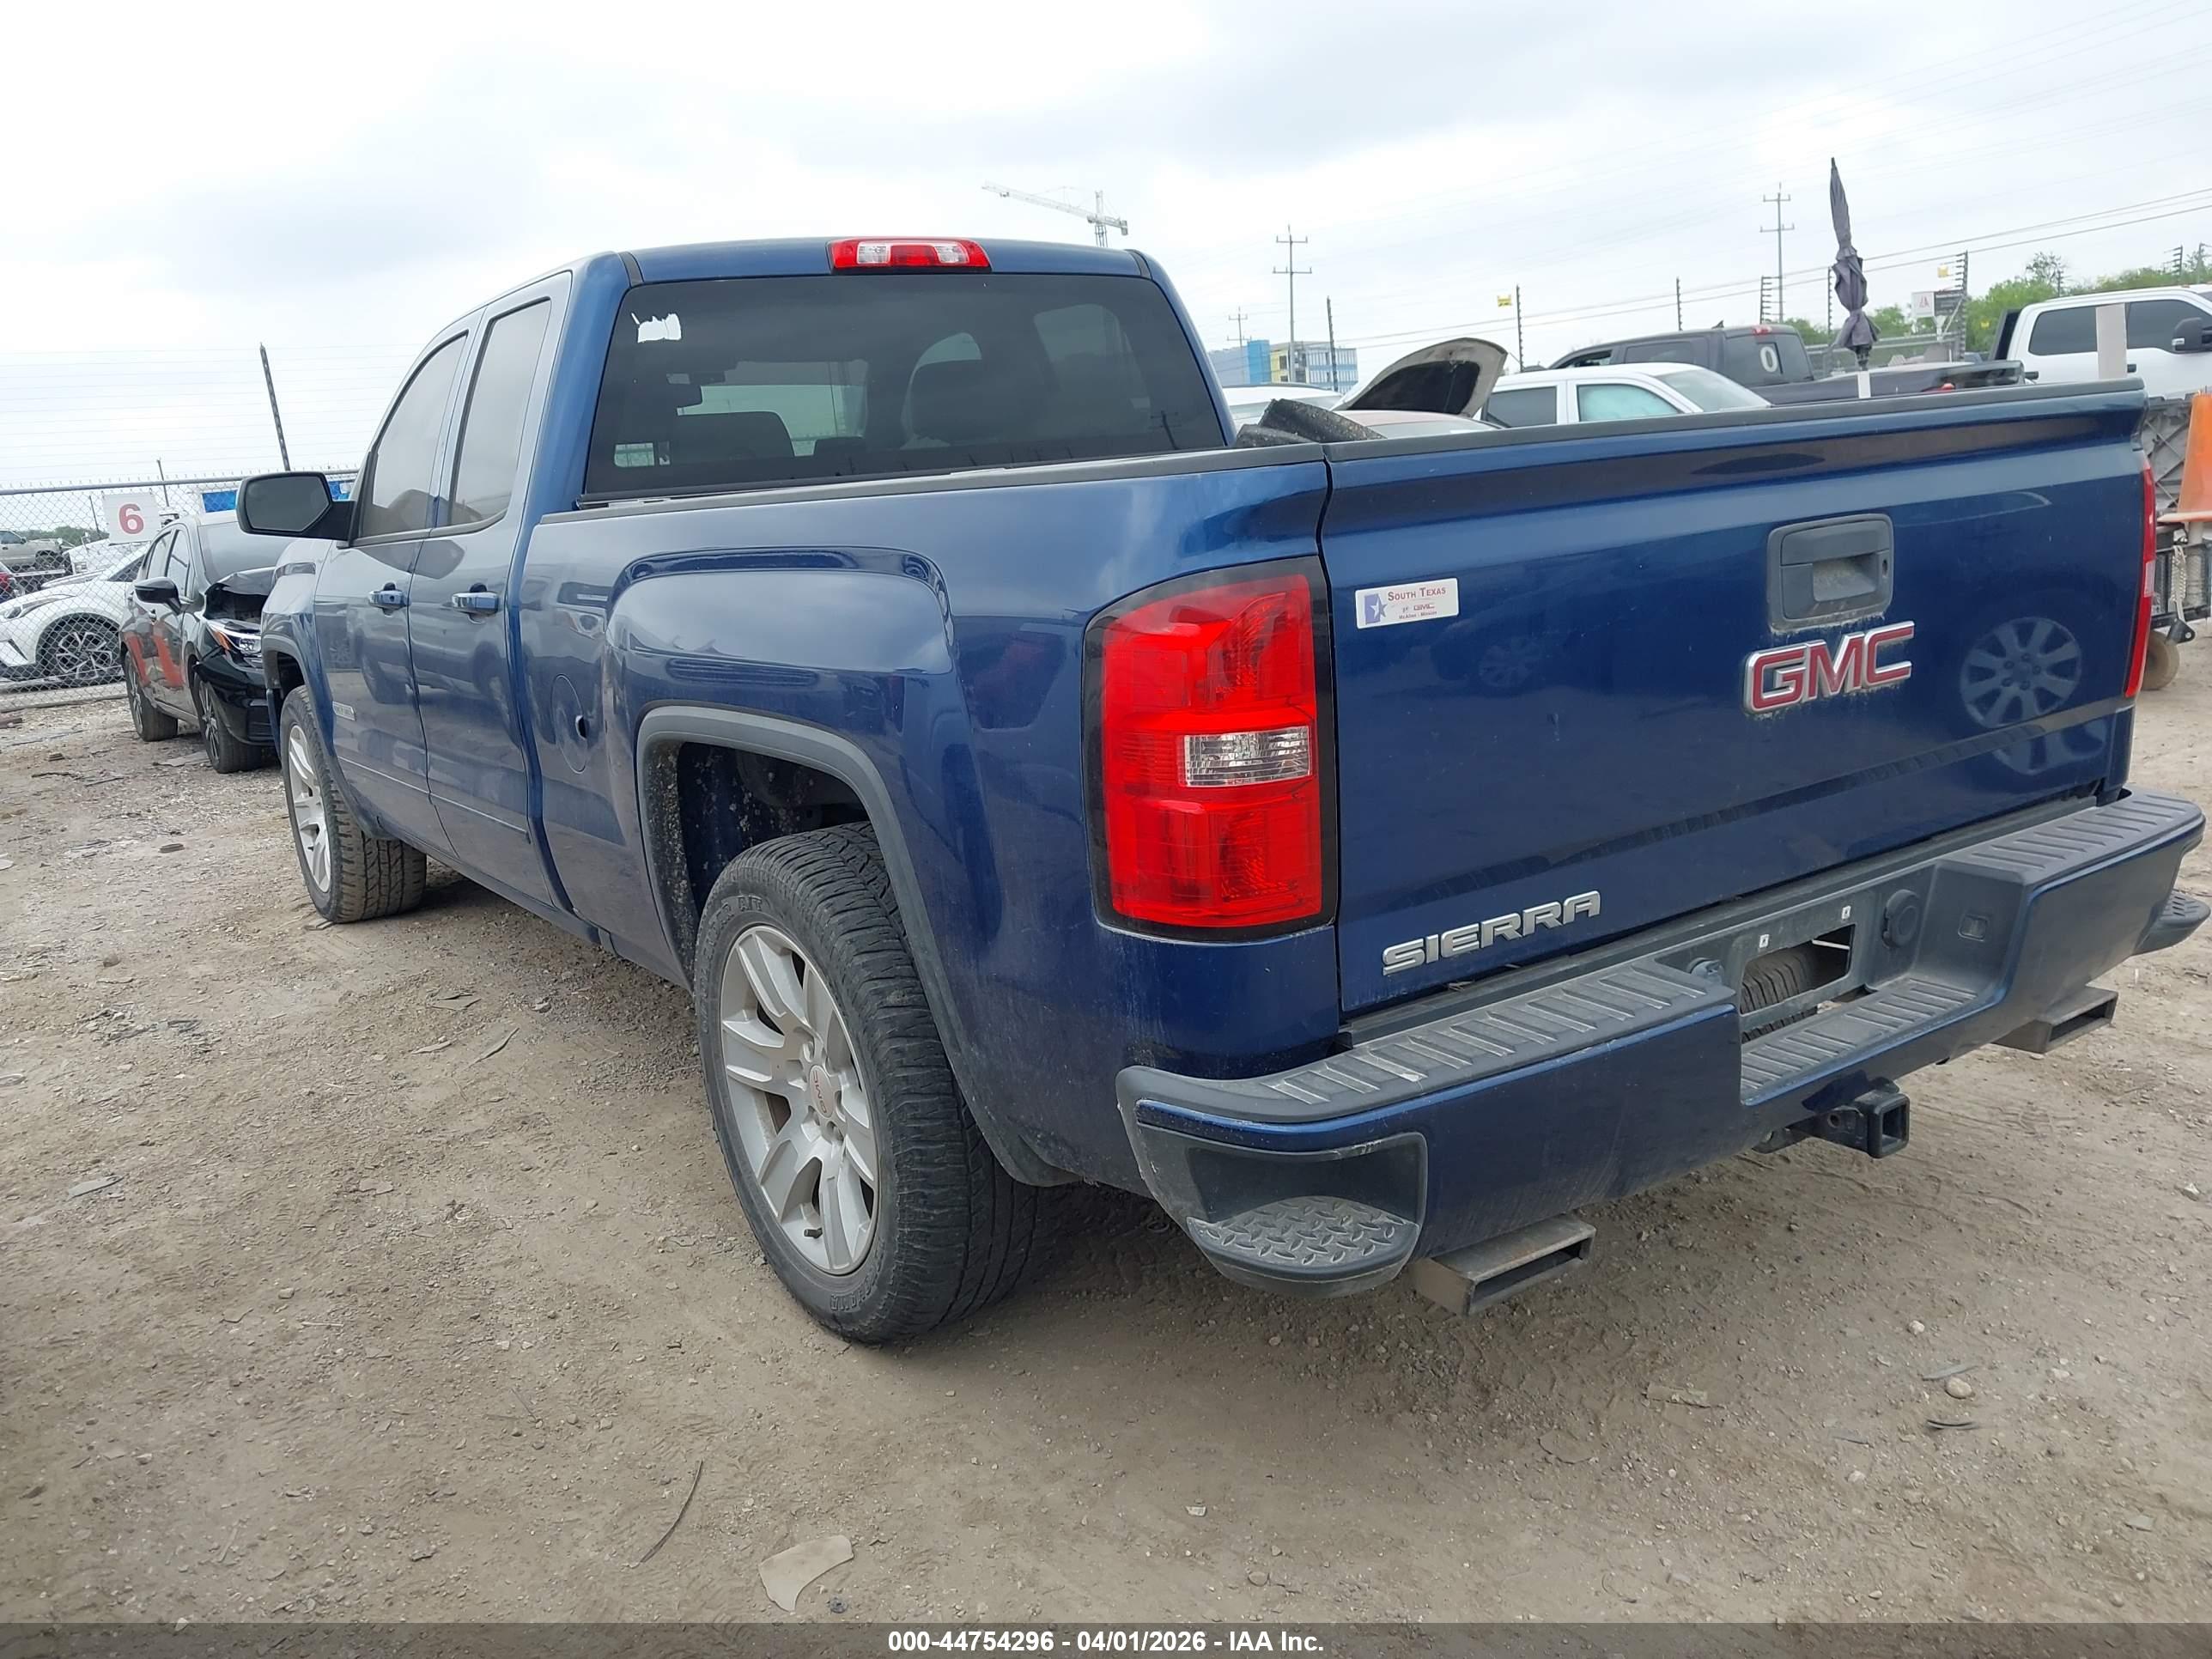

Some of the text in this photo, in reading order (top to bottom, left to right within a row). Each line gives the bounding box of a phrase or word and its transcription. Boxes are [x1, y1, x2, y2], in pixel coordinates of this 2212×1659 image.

[118, 503, 144, 535] 6
[1744, 621, 1915, 714] GMC
[1382, 890, 1601, 977] SIERRA
[812, 1070, 827, 1114] GMC
